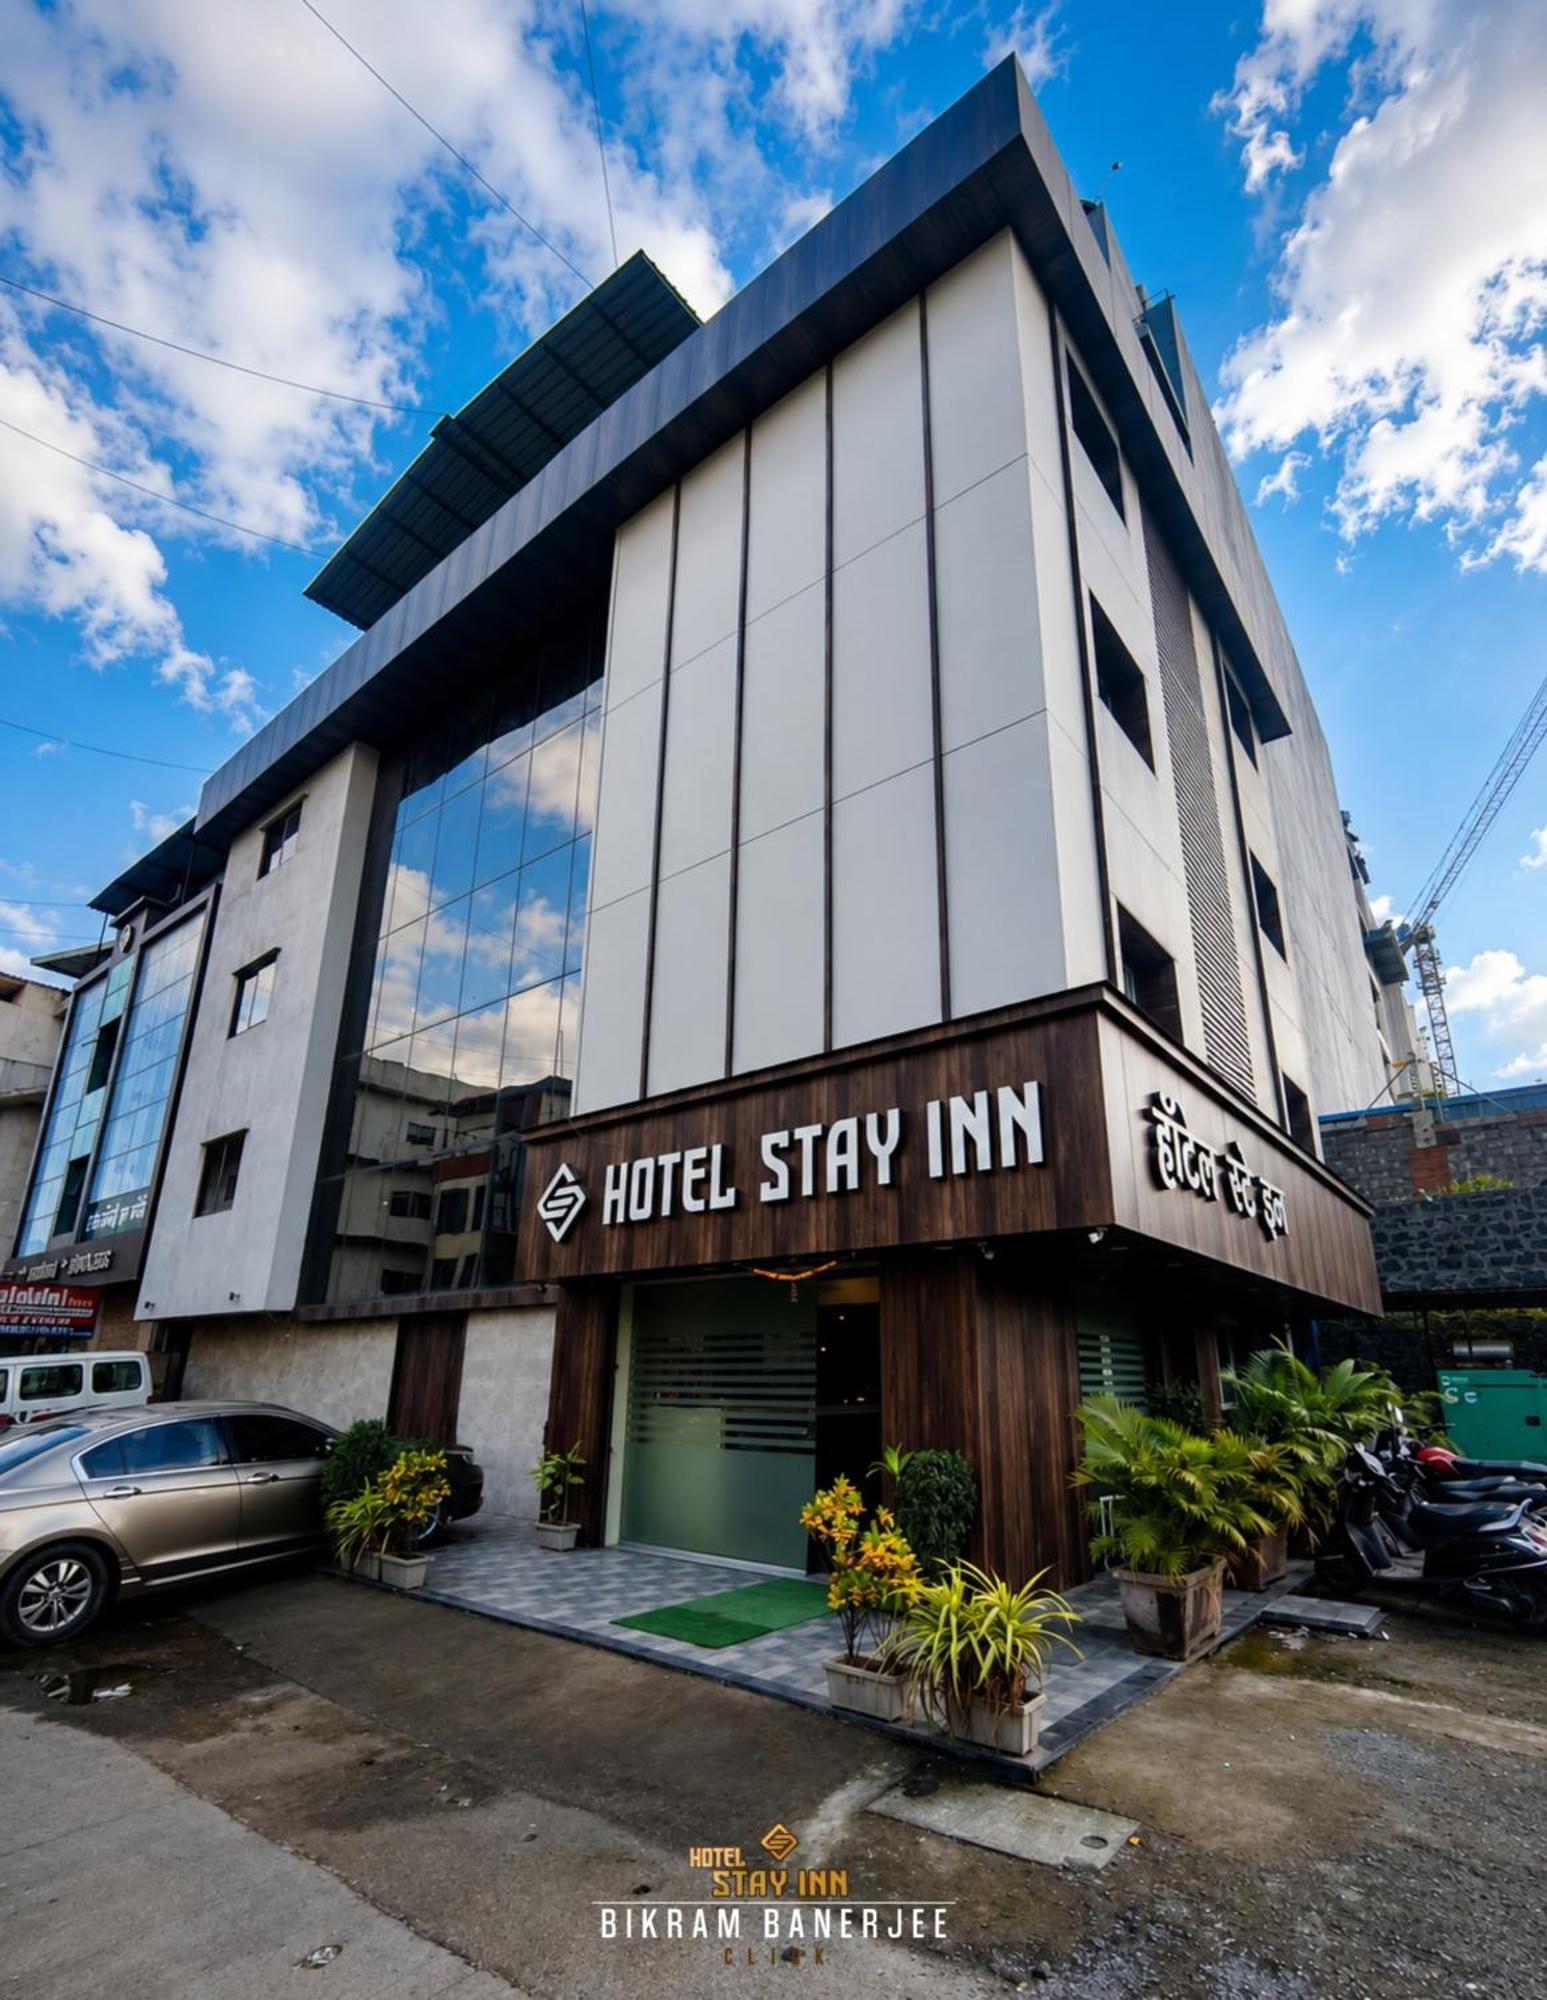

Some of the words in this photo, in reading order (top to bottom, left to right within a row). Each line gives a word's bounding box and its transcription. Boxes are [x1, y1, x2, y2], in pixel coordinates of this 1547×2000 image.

[602, 1143, 736, 1226] HOTEL
[760, 1107, 901, 1203] STAY
[926, 1080, 1045, 1179] INN
[1259, 1176, 1290, 1241] इन
